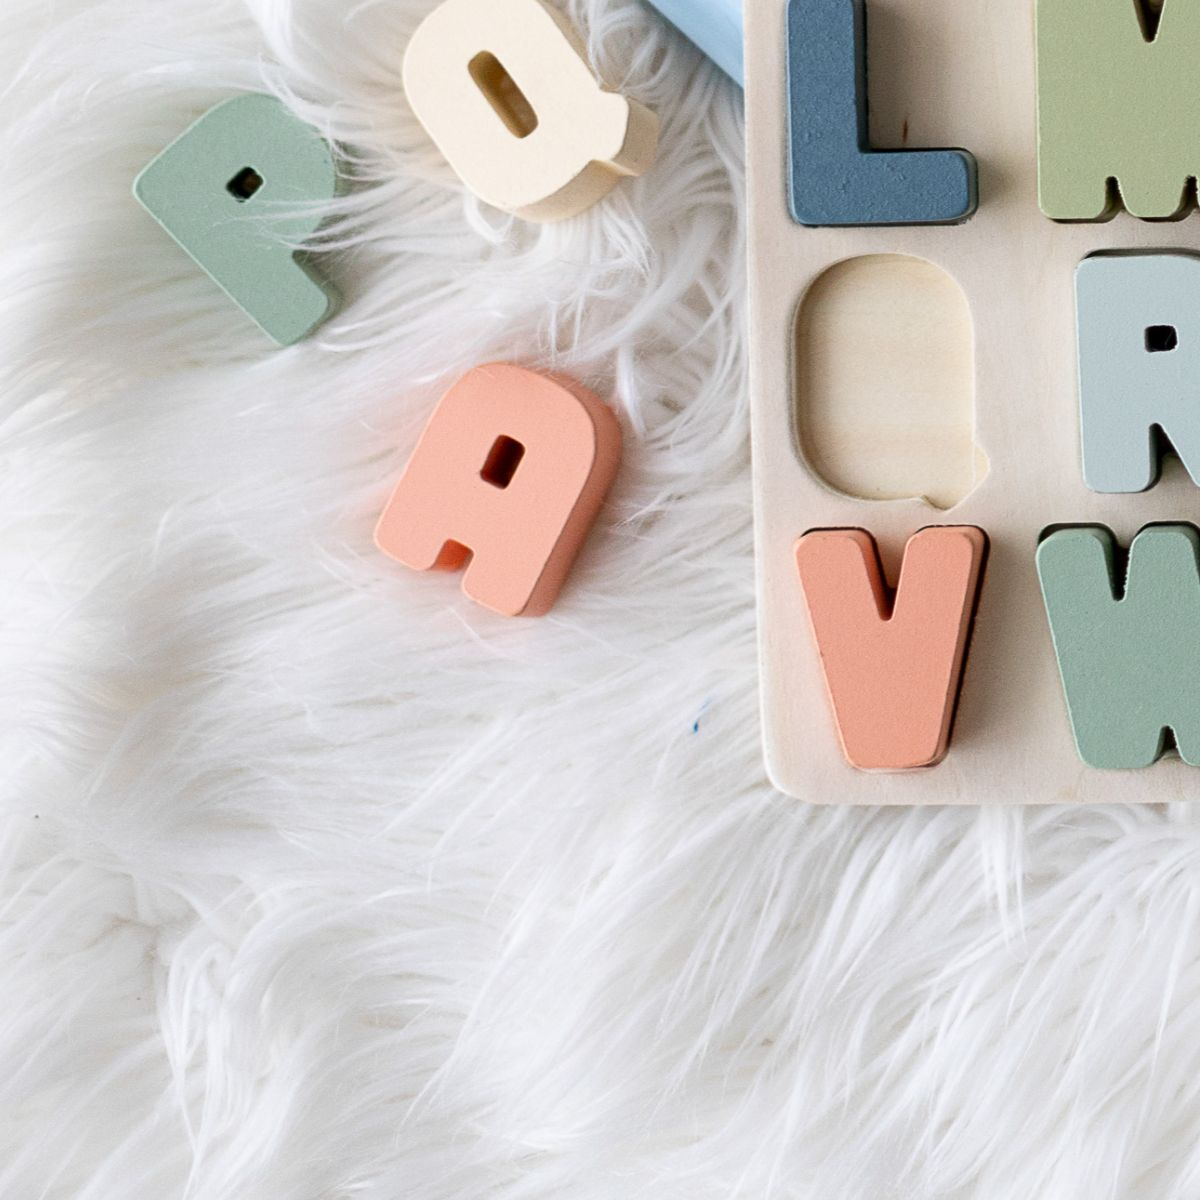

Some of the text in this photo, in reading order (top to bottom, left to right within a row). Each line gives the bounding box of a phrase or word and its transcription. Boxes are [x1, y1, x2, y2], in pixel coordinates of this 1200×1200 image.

[132, 90, 338, 346] P
[373, 361, 622, 617] A
[793, 525, 987, 769] V
